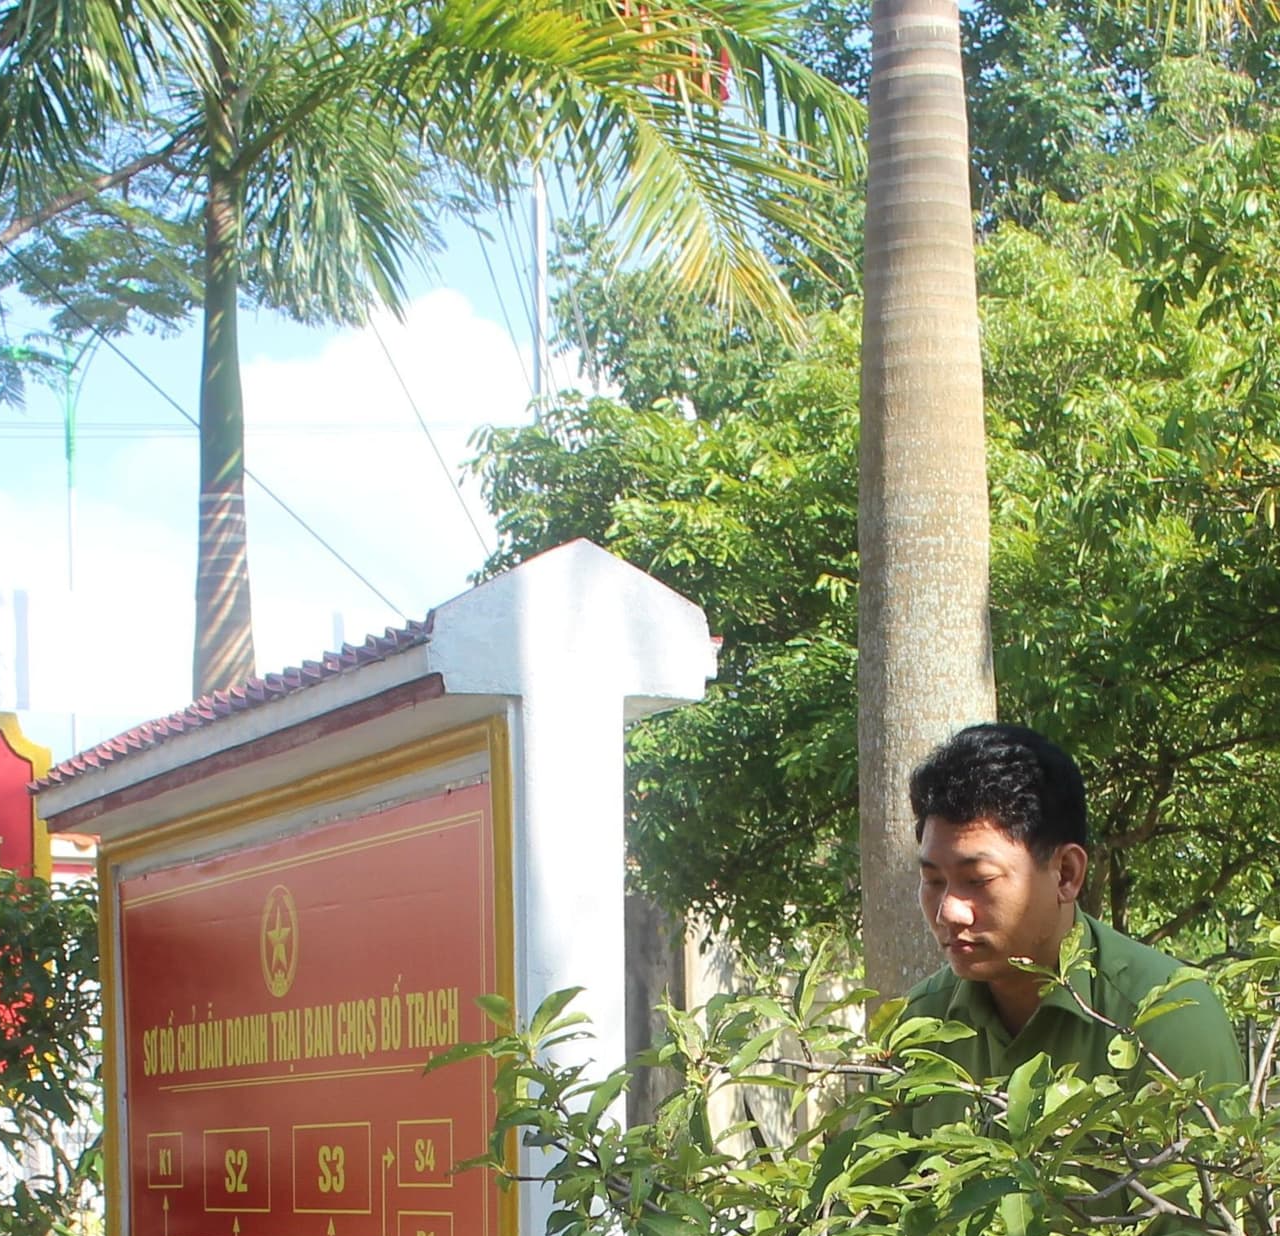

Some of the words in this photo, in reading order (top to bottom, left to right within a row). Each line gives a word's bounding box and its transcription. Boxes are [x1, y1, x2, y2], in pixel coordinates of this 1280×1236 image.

[144, 1025, 158, 1077] SƠ
[178, 1004, 197, 1072] CHỈ
[199, 1002, 223, 1070] DẪN
[226, 1014, 268, 1067] DOANH
[271, 1008, 300, 1073] TRẠI
[305, 1004, 333, 1058] BAN
[337, 997, 376, 1060] CHQS
[381, 973, 401, 1051] BỐ
[406, 987, 459, 1060] TRẠCH
[160, 1148, 172, 1175] K1
[225, 1149, 248, 1193] S2
[318, 1145, 345, 1193] S3
[414, 1138, 436, 1173] S4
